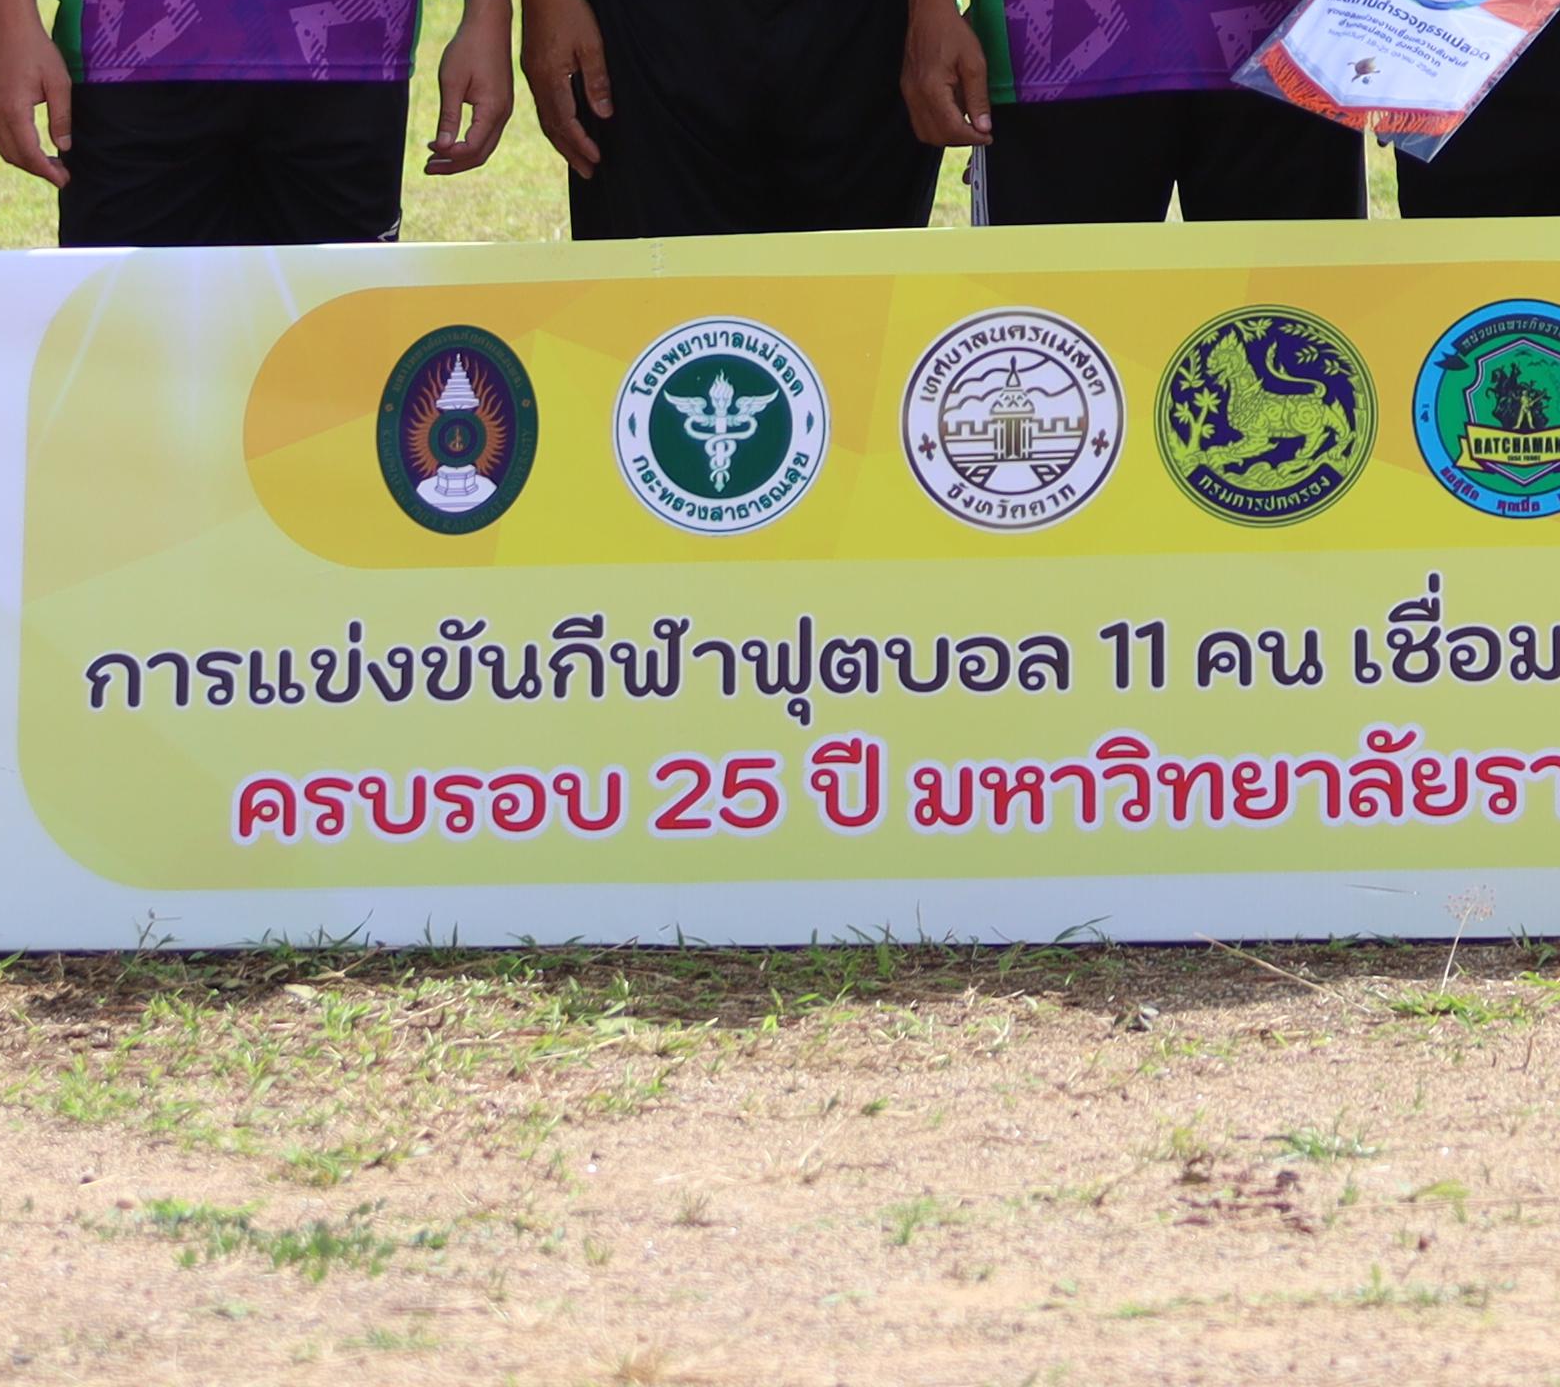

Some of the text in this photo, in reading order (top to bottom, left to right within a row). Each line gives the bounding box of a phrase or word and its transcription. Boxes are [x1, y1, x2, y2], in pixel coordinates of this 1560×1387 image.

[630, 330, 805, 397] โรงพยาบาลแม่สอด
[920, 325, 1106, 403] เทศบาลนครแม่สอด
[633, 451, 810, 521] กระทรวงสาธารณสุข
[947, 482, 1076, 519] จังหวัดตาก
[1199, 474, 1331, 511] กรมการปกครอง
[86, 614, 1069, 725] การแข่งขันกีฬาฟุตบอล
[1100, 622, 1164, 688] 11
[1197, 630, 1323, 687] คน
[240, 772, 621, 837] ครบรอบ
[656, 758, 779, 830] 25
[811, 738, 879, 827] ปี
